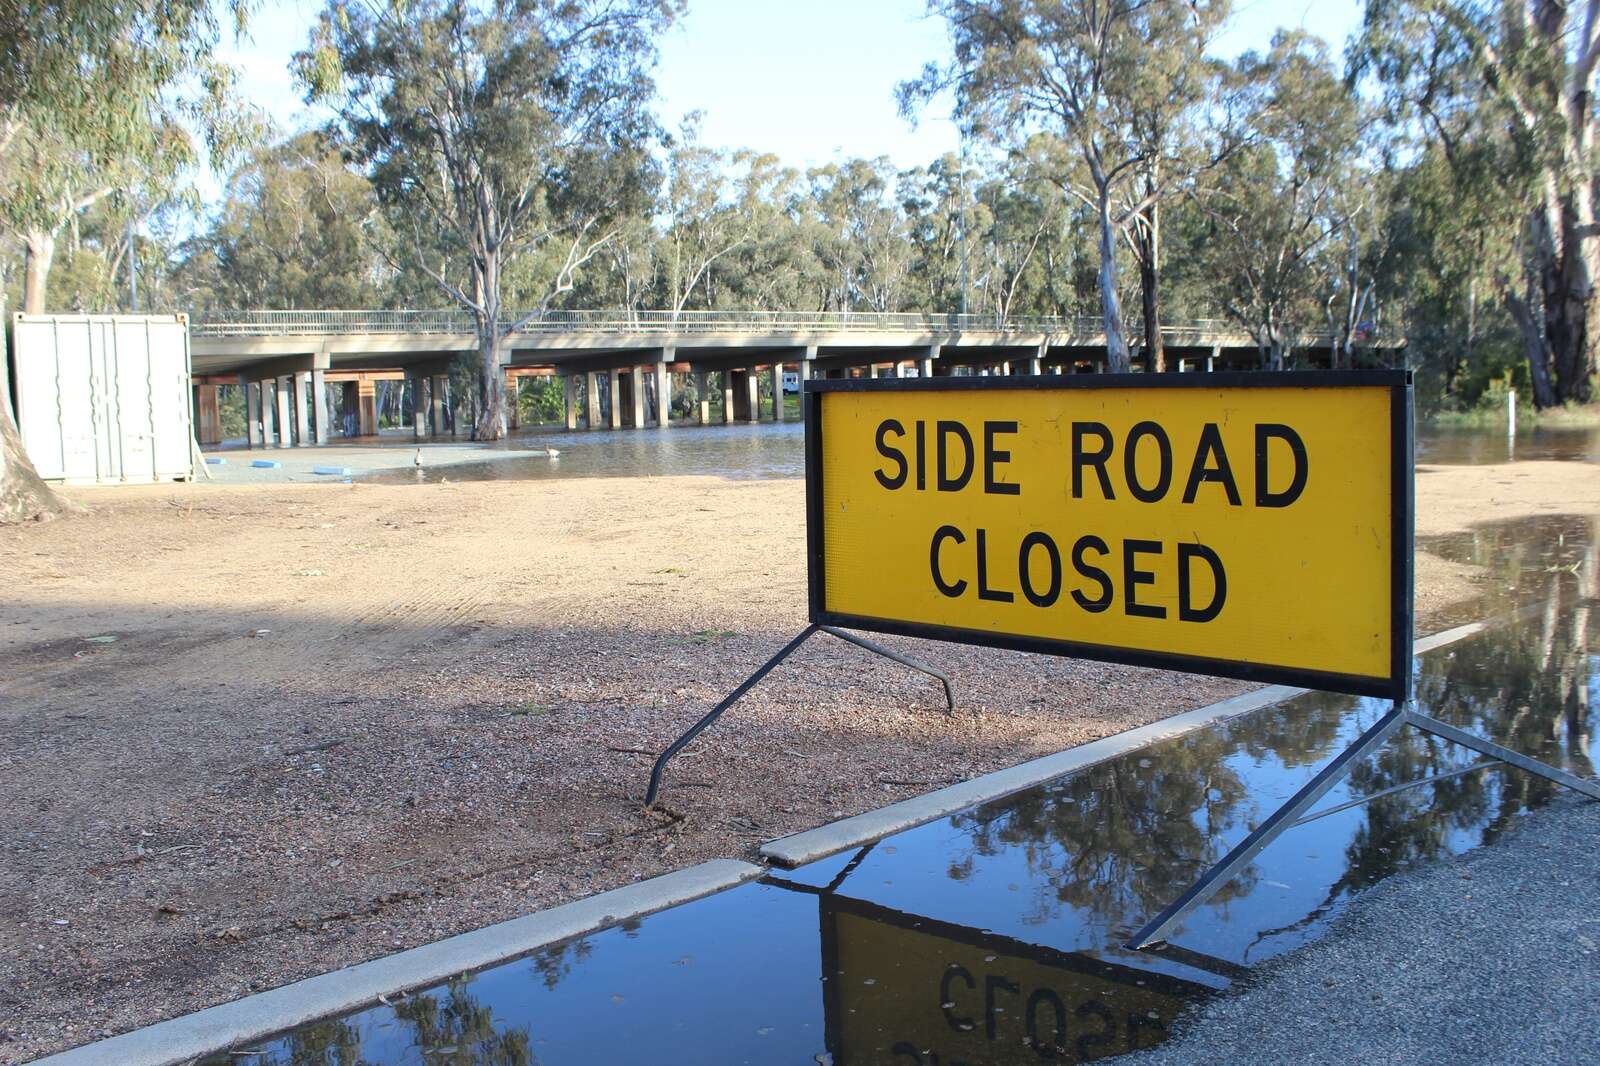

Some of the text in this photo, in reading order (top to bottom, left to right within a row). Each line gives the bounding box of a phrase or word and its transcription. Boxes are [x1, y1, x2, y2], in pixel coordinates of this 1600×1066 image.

[874, 419, 1309, 508] SIDE ROAD
[930, 525, 1227, 623] CLOSED
